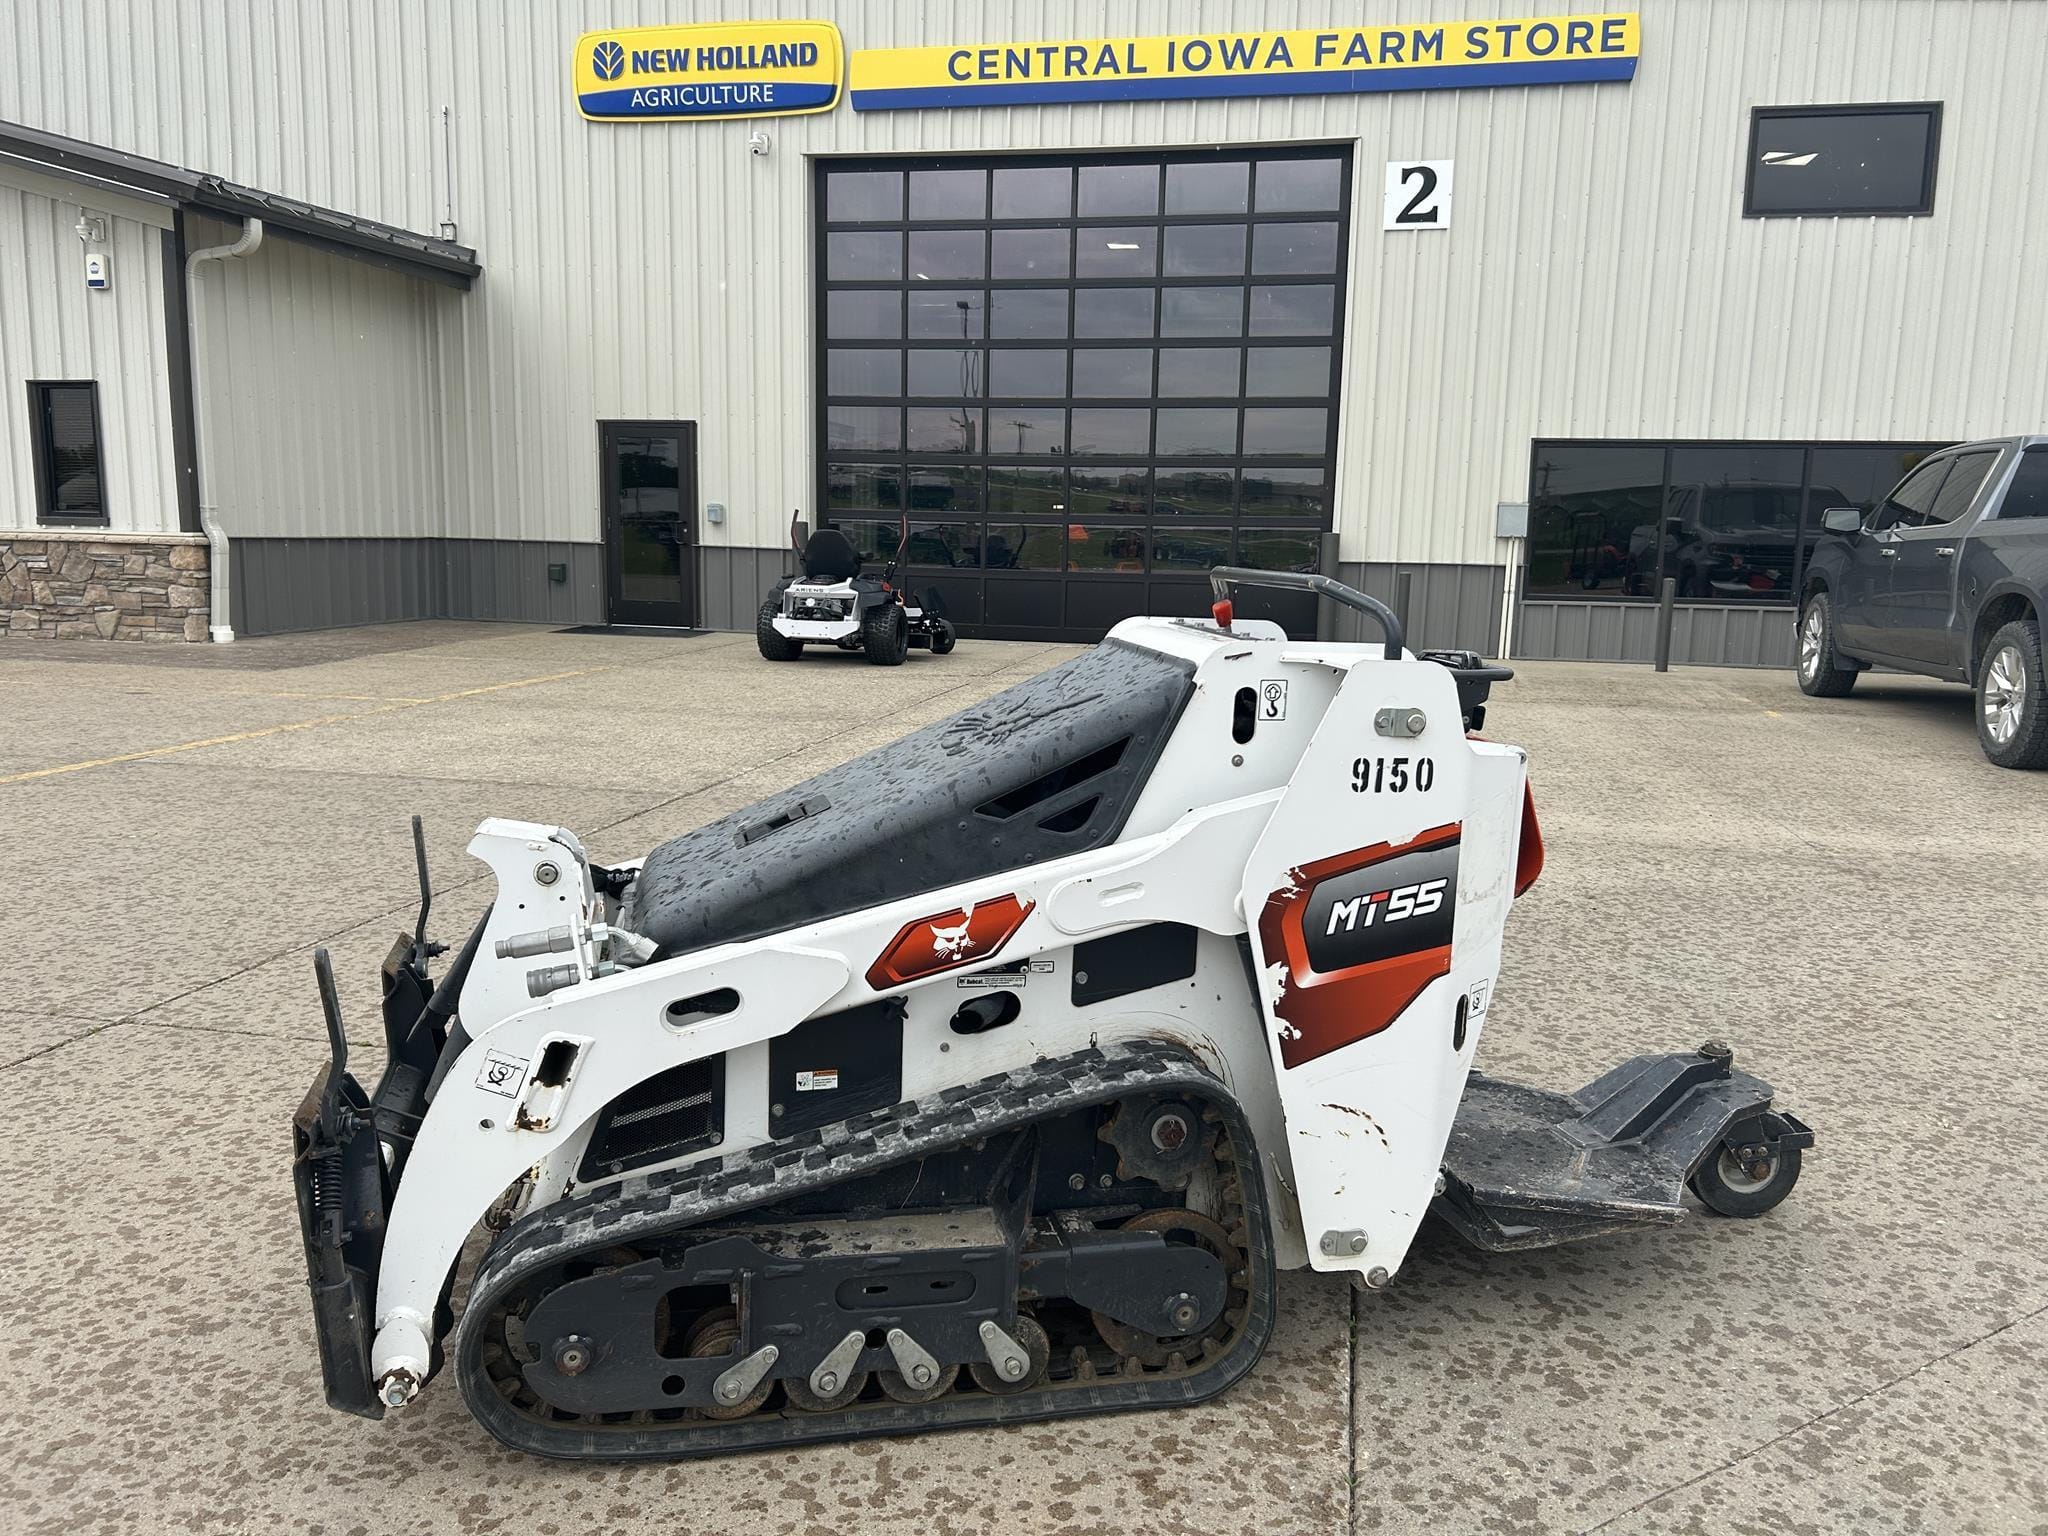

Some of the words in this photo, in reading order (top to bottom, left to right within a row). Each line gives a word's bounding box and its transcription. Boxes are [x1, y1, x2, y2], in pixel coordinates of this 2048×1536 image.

[632, 49, 688, 74] NEW
[696, 42, 818, 71] HOLLAND
[948, 39, 1147, 81] CENTRAL
[1167, 37, 1294, 72] IOWA
[1315, 29, 1444, 66] FARM
[1466, 19, 1627, 59] STORE
[631, 84, 774, 108] AGRICULTURE
[1395, 166, 1438, 223] 2
[1352, 758, 1433, 792] 9150
[1326, 878, 1448, 935] MT55
